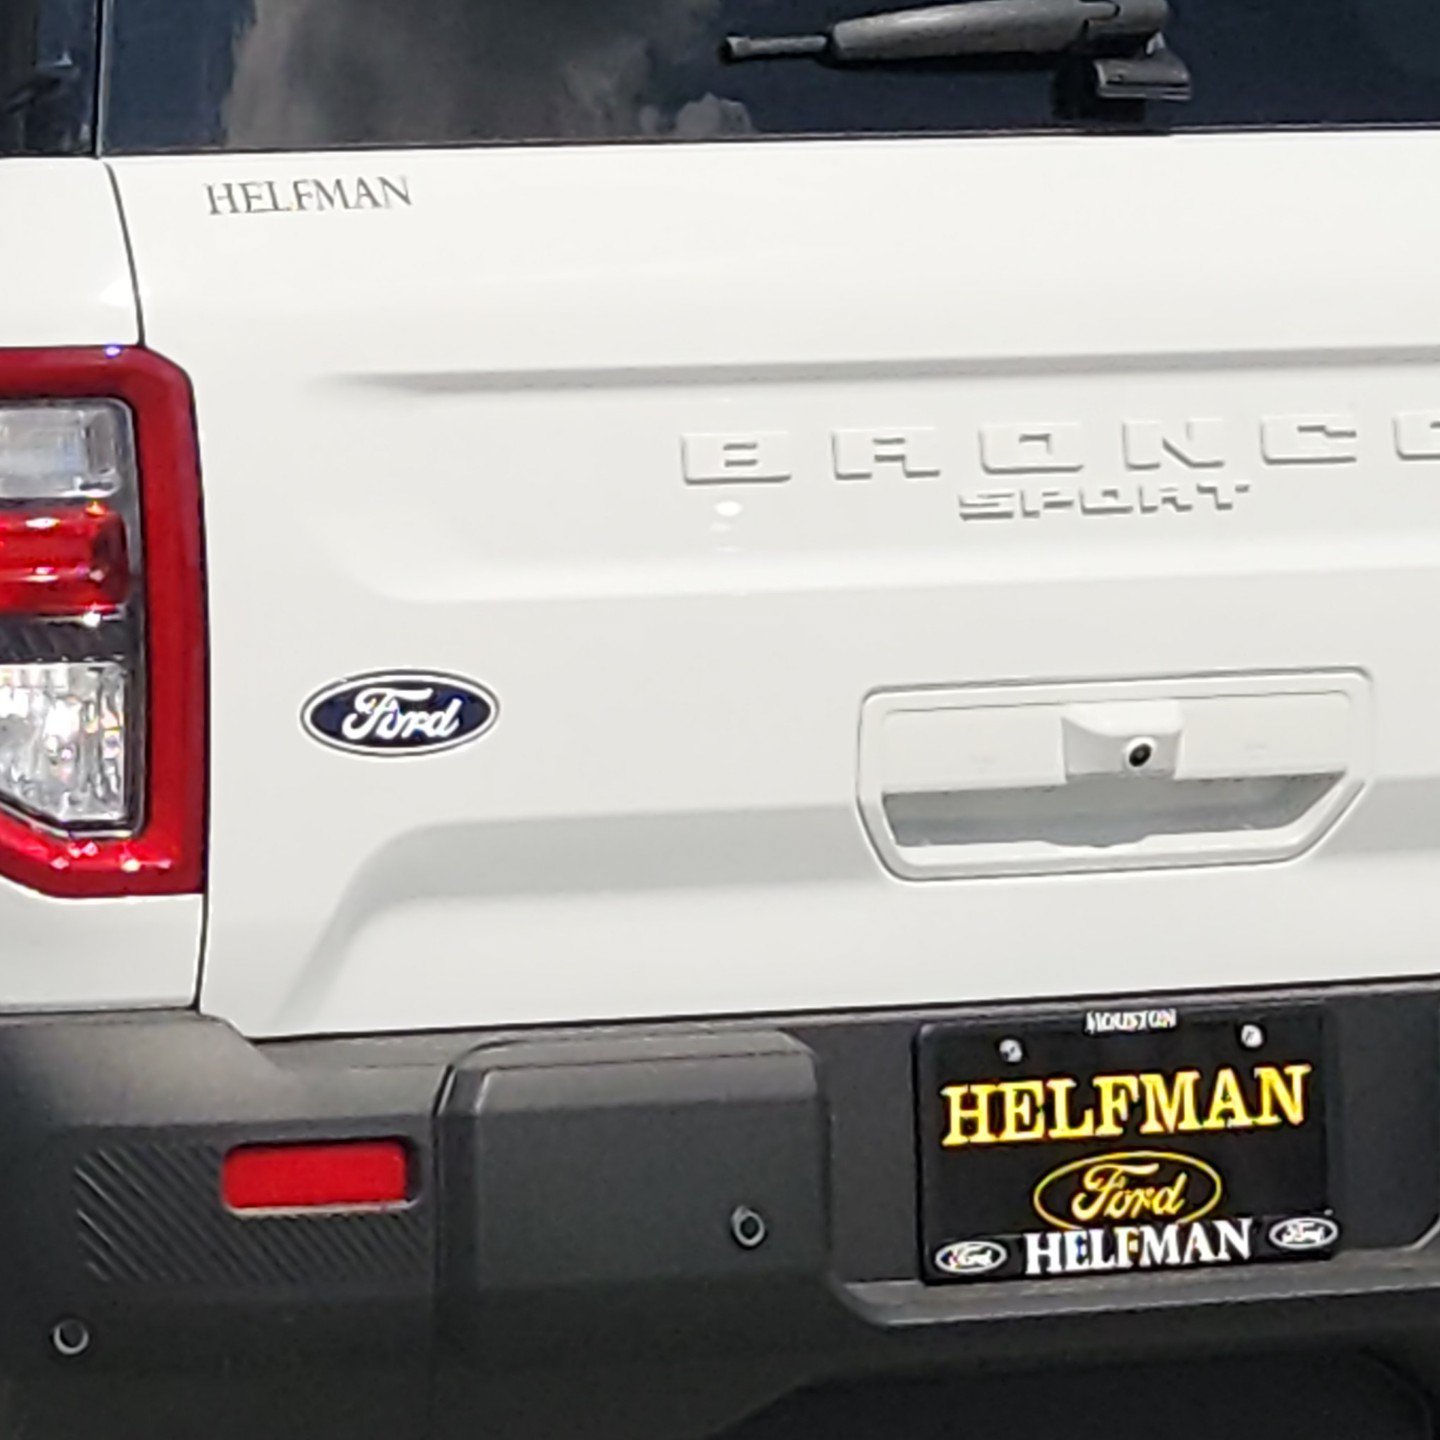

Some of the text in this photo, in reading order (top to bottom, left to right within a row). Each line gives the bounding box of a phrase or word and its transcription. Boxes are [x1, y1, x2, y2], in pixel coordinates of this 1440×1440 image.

[205, 174, 413, 215] HELFMAN
[958, 481, 1251, 520] SPORT
[341, 687, 464, 740] Ford
[1085, 1008, 1177, 1035] HOUSTON
[940, 1063, 1313, 1148] HELFMAN
[1070, 1160, 1188, 1221] Ford
[1024, 1217, 1254, 1276] HELFMAN
